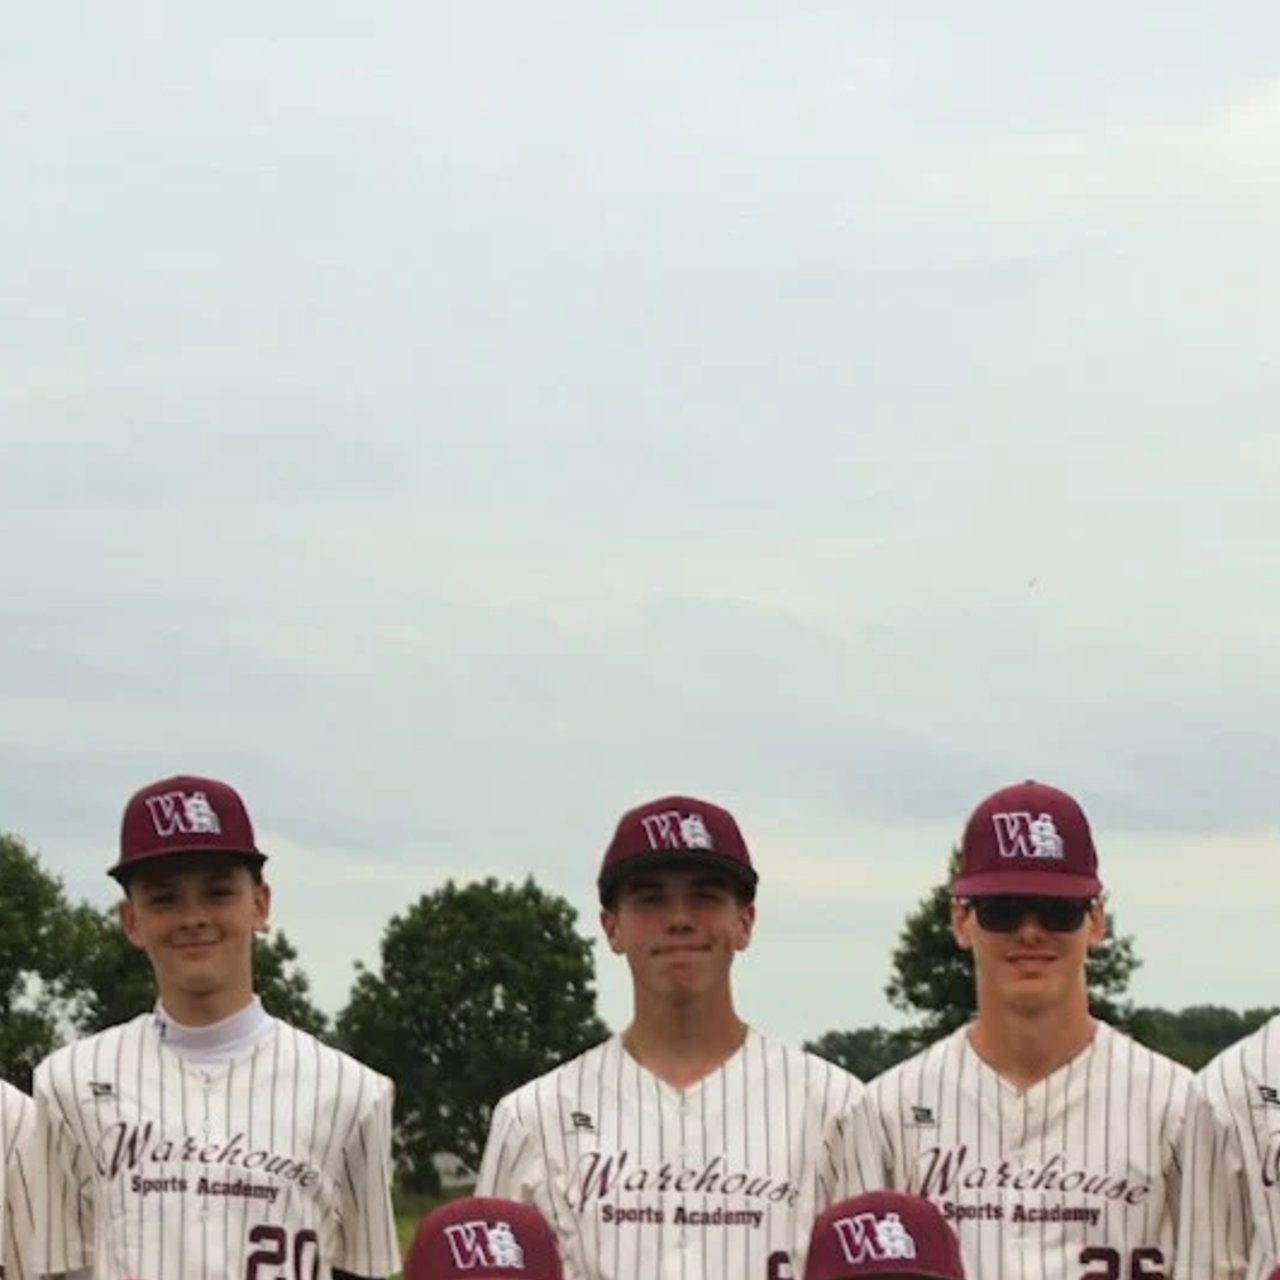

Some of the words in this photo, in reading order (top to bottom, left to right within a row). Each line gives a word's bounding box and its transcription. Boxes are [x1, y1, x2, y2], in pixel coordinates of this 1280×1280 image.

[96, 1121, 320, 1188] Warehouse
[131, 1175, 187, 1196] Sports
[198, 1177, 280, 1204] Academy
[919, 1145, 1151, 1205] Warehouse
[602, 1204, 665, 1227] Sports
[674, 1206, 764, 1230] Academy
[944, 1203, 1004, 1223] Sports
[1012, 1204, 1101, 1226] Academy
